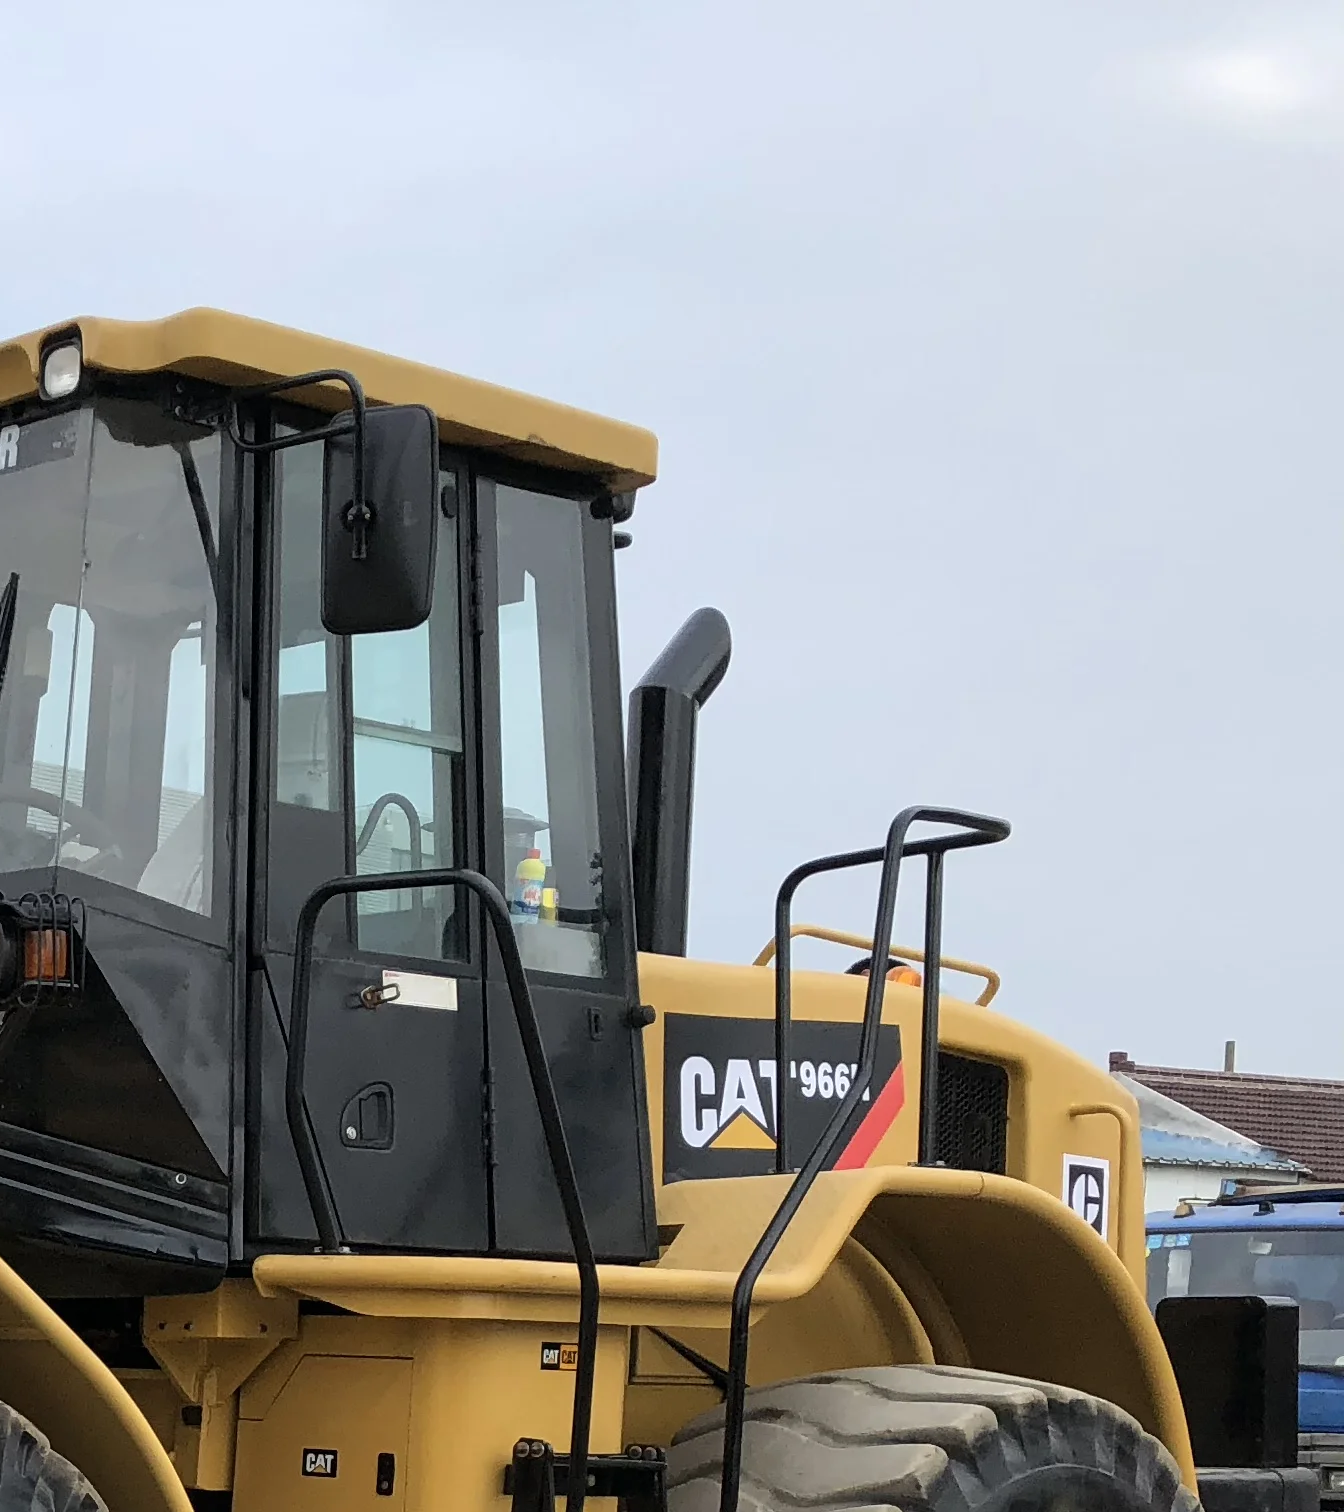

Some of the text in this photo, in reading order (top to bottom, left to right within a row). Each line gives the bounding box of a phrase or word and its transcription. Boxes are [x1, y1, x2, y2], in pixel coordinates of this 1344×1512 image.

[543, 1348, 578, 1364] CAT CAT
[306, 1452, 334, 1473] CAT
